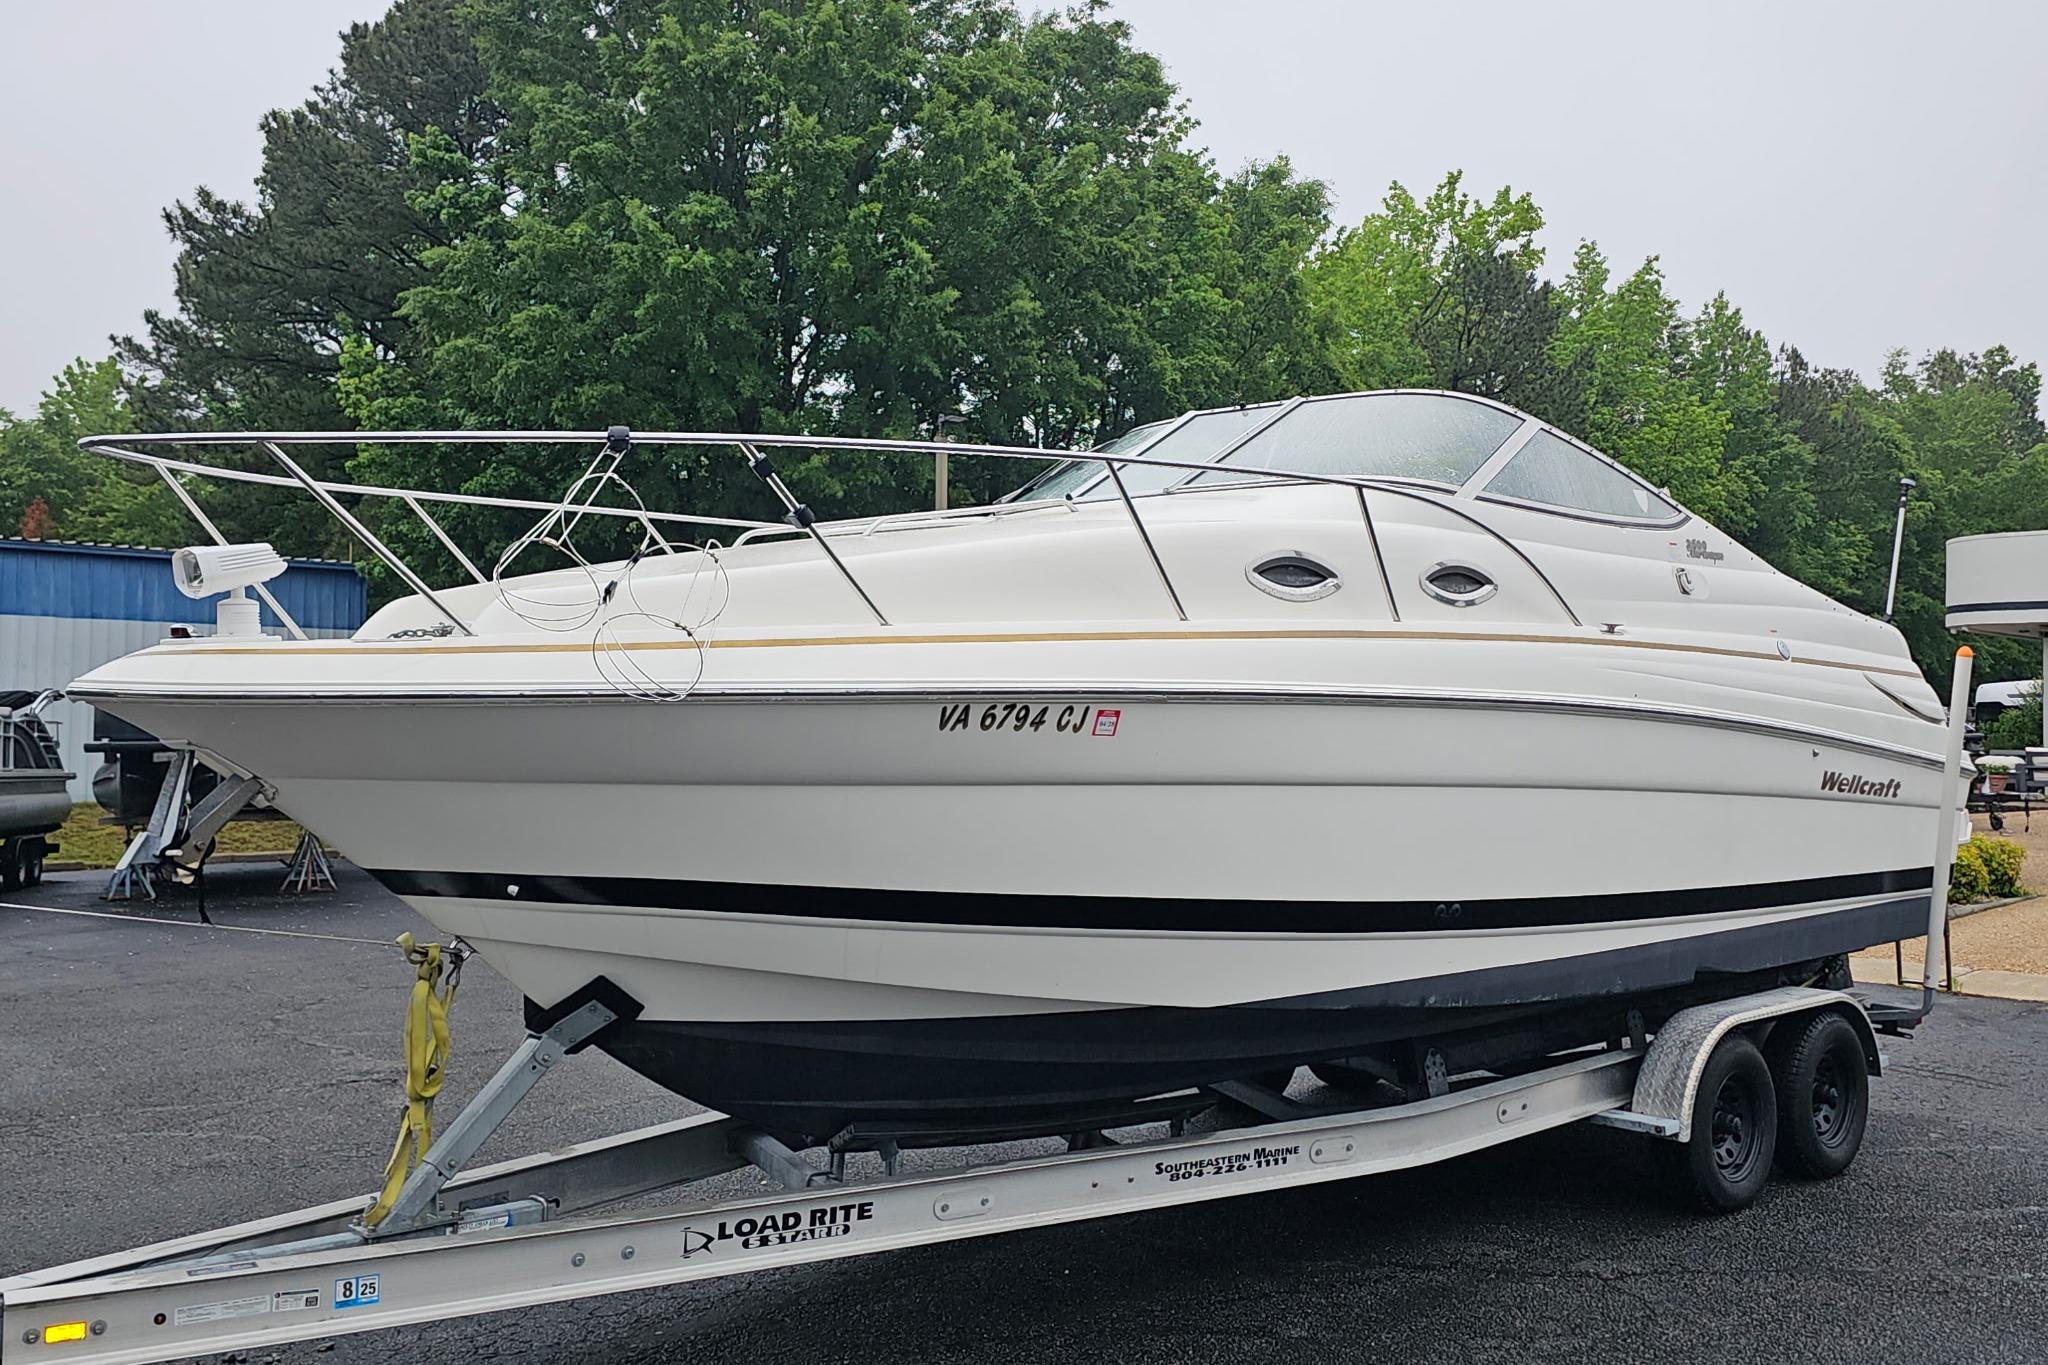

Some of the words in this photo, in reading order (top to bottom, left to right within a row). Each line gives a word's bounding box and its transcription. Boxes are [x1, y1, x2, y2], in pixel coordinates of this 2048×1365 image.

[938, 704, 971, 732] VA
[980, 703, 1049, 732] 6794
[1056, 705, 1090, 733] CJ
[1820, 770, 1901, 798] Wellcraft
[1169, 1156, 1288, 1182] 804-226-1111
[717, 1211, 802, 1240] LOAD
[809, 1202, 874, 1228] RITE
[748, 1236, 762, 1248] 5
[768, 1224, 845, 1246] STARR
[342, 1281, 353, 1299] 8
[360, 1282, 376, 1296] 25
